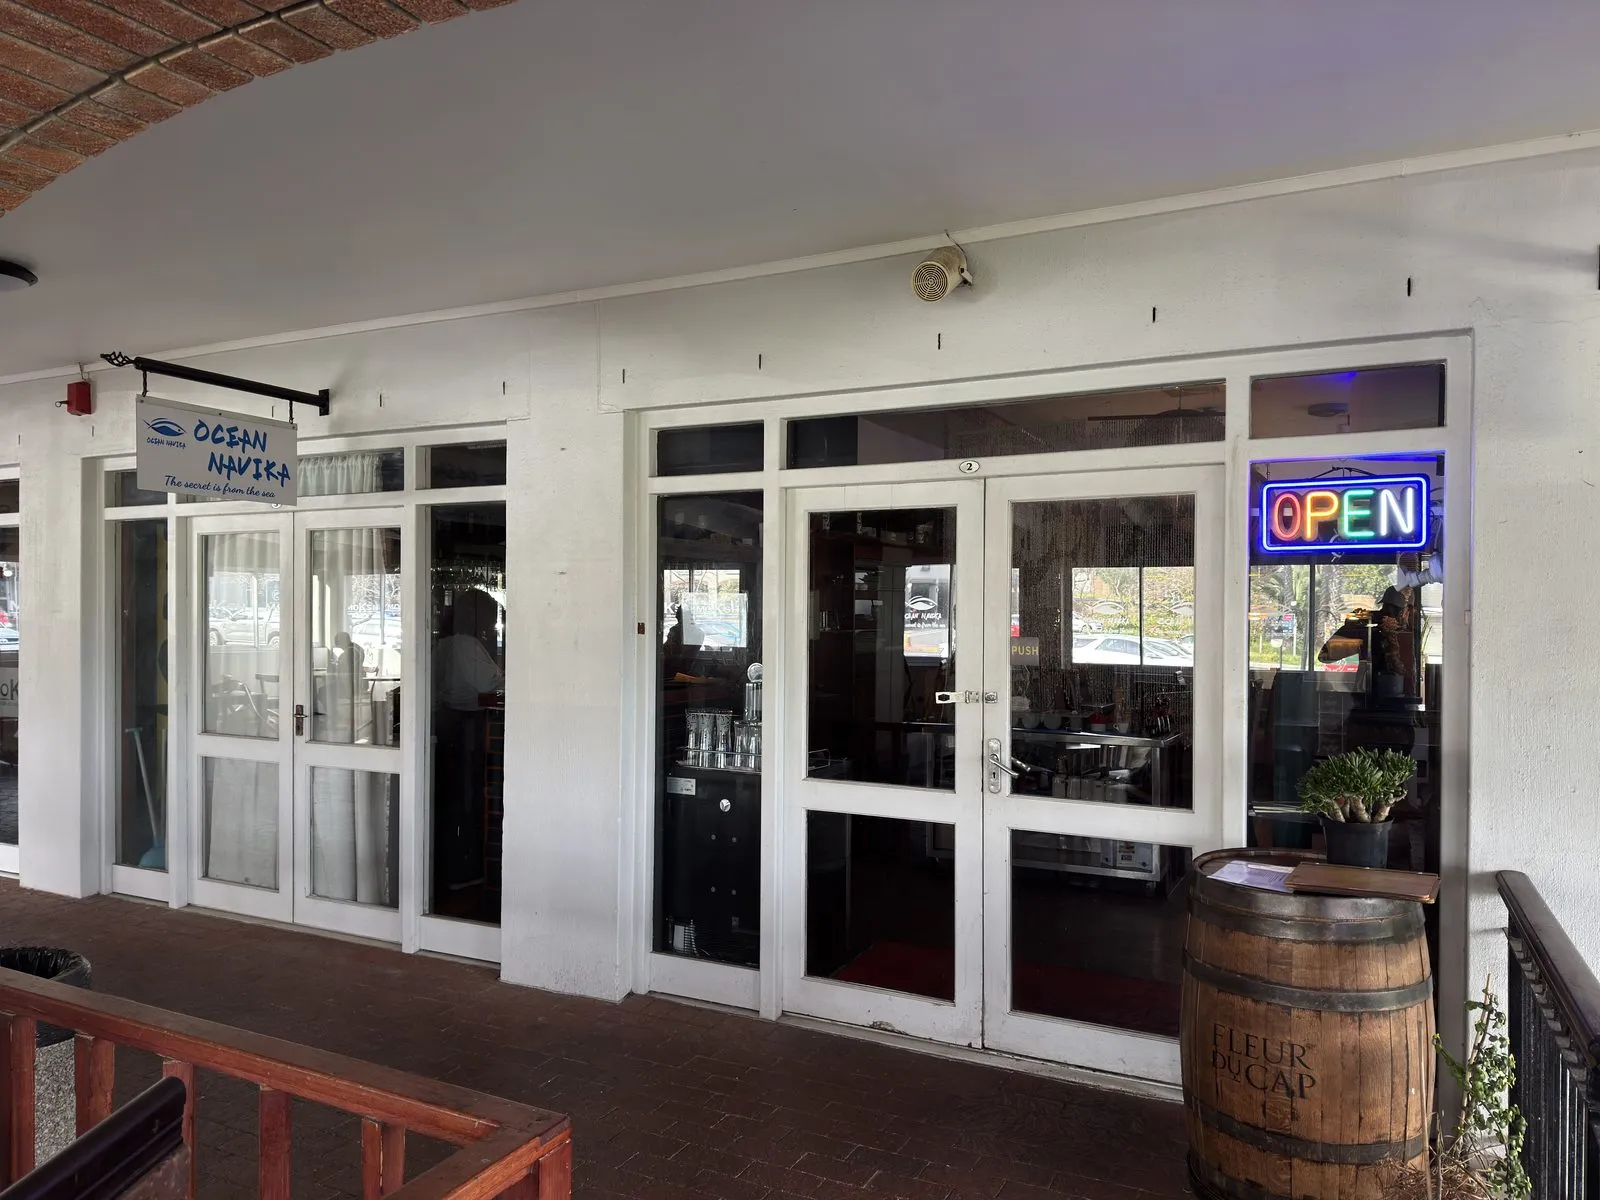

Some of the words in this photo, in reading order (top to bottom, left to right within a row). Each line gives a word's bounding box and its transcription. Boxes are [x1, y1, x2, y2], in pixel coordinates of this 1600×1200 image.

[147, 437, 164, 446] OCEAN
[194, 419, 267, 453] OCEAN
[165, 475, 182, 487] The
[184, 481, 212, 491] secret
[213, 484, 220, 492] is
[222, 483, 244, 495] from
[245, 486, 260, 496] the
[261, 490, 275, 498] sea
[208, 451, 291, 487] NAVIKA
[1272, 488, 1415, 541] OPEN
[1012, 645, 1039, 656] PUSH
[1213, 1023, 1312, 1070] FLEUR
[1212, 1050, 1241, 1082] DU
[1245, 1063, 1316, 1099] CAP
